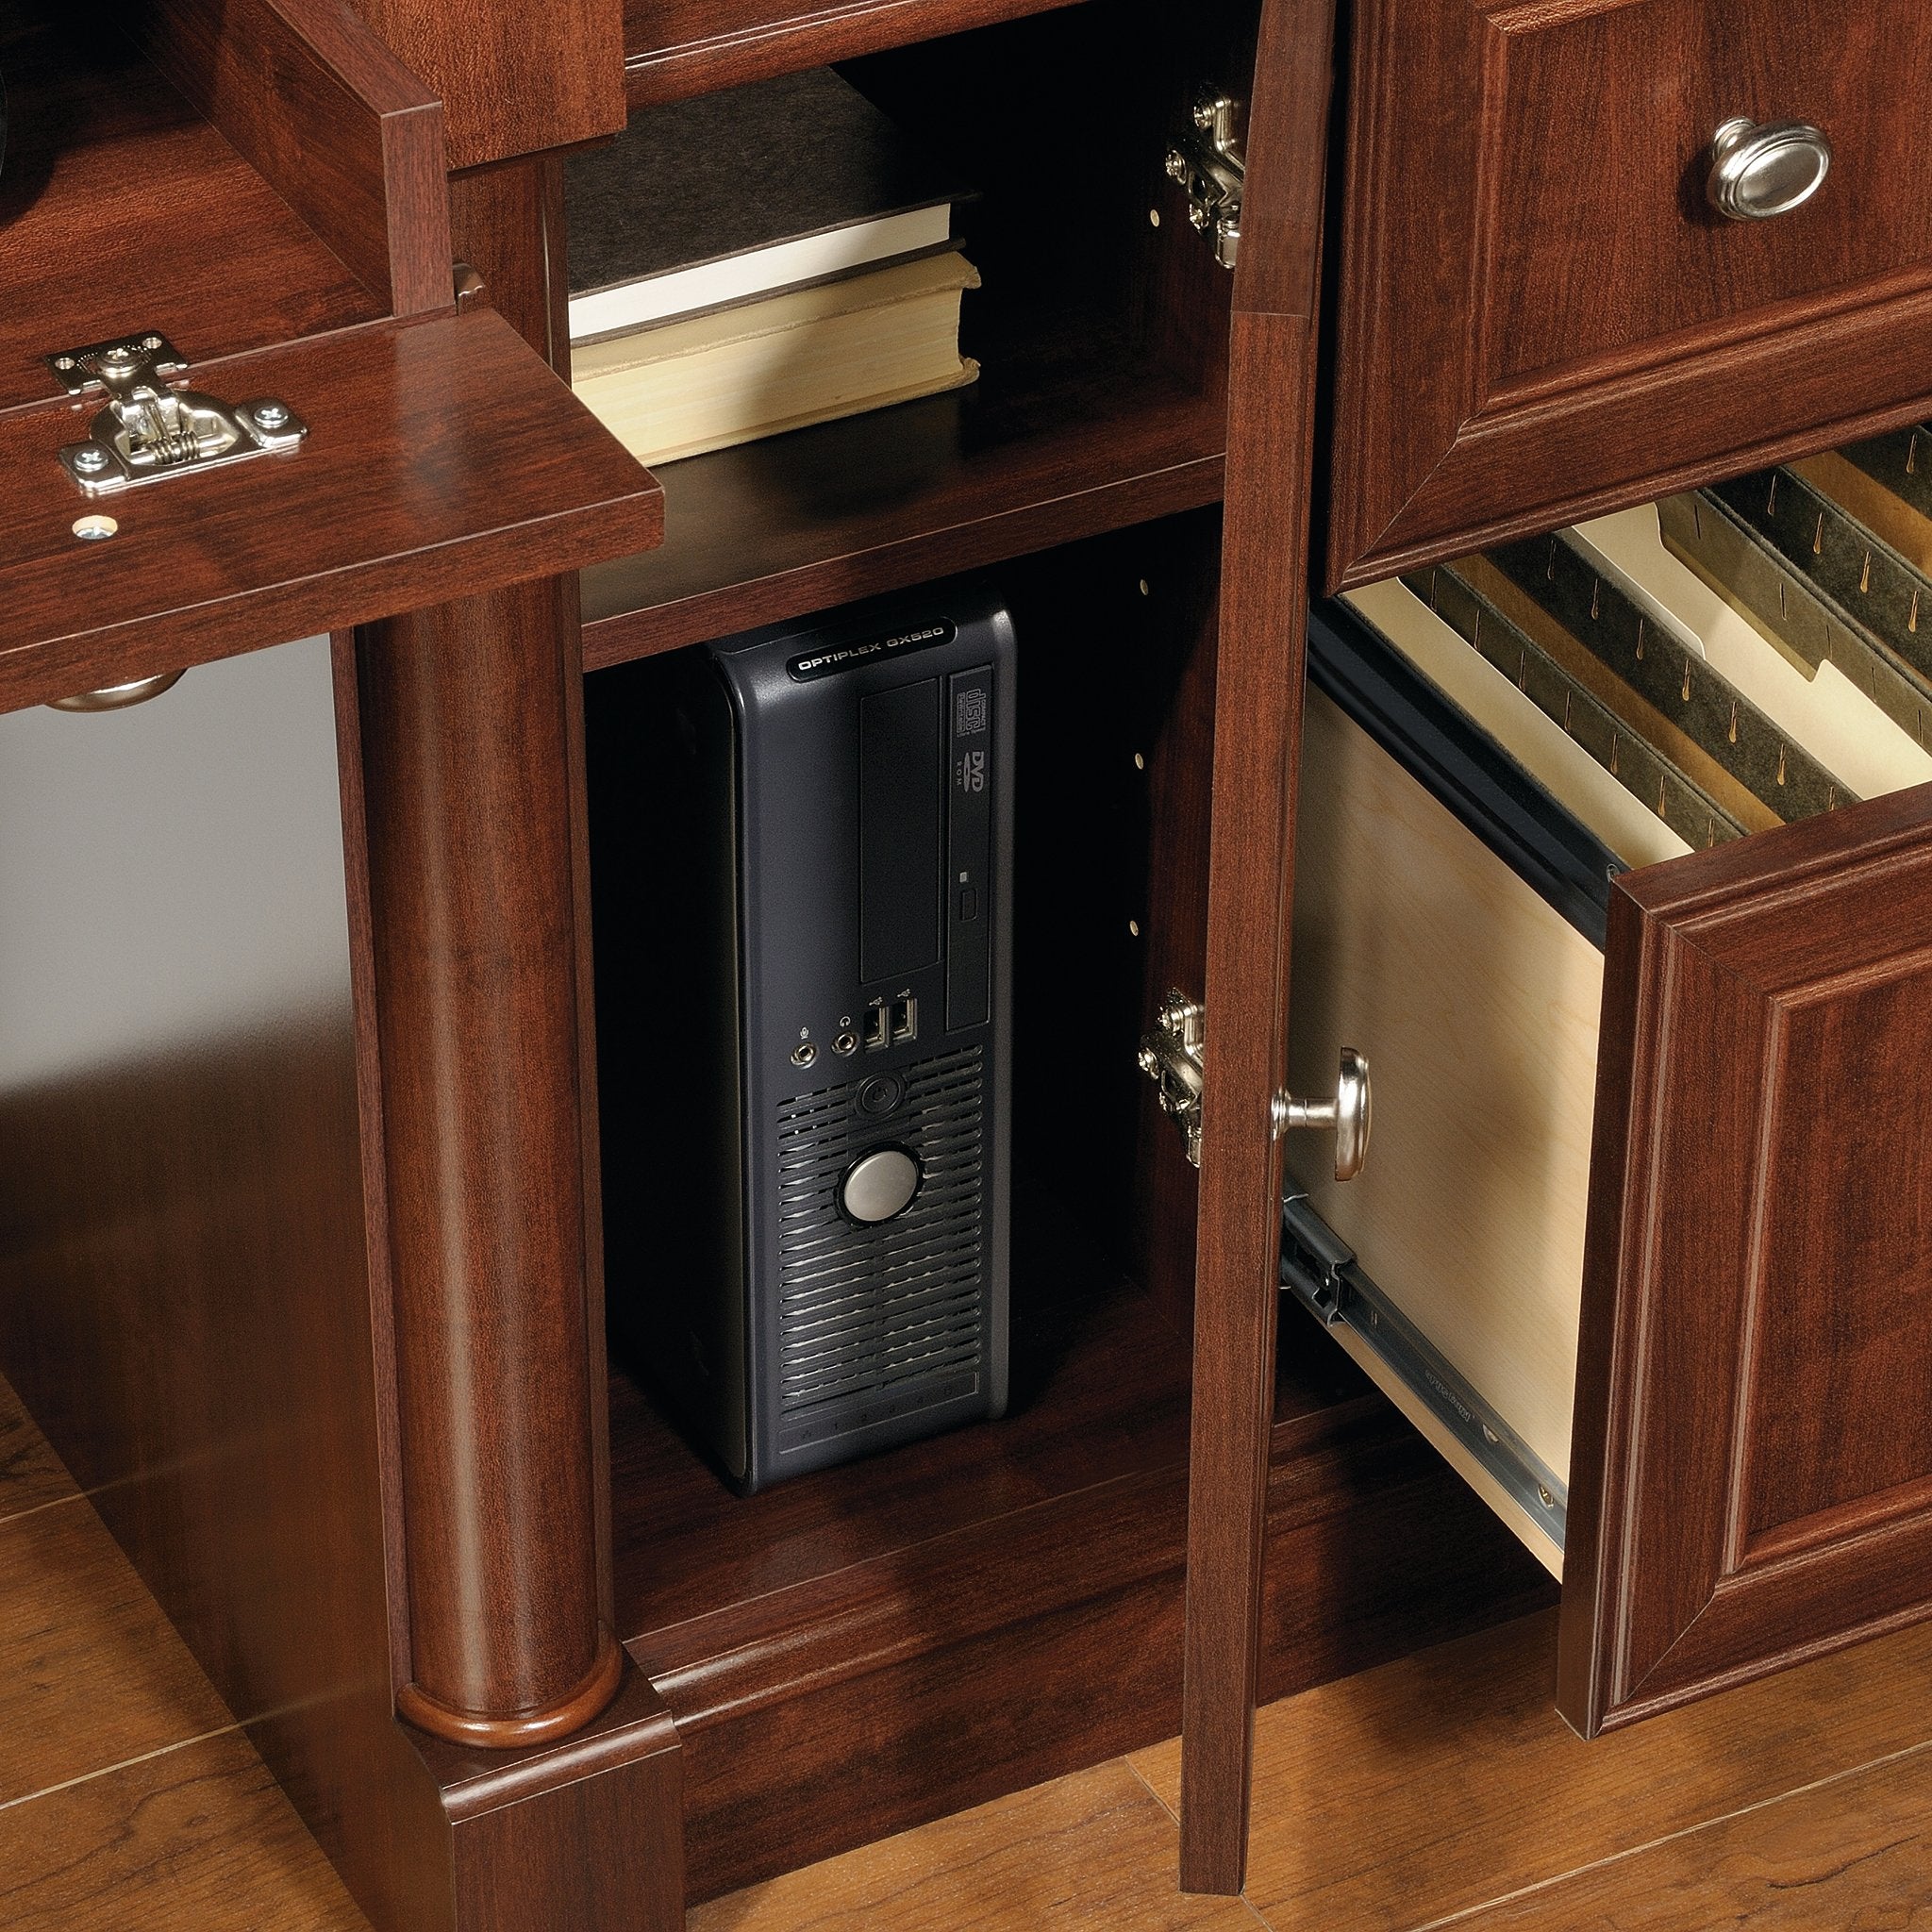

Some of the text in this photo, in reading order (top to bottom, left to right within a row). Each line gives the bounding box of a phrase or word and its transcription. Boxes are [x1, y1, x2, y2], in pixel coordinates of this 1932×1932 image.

[798, 626, 944, 671] OPTIPLEX GX520
[970, 751, 985, 792] DVD
